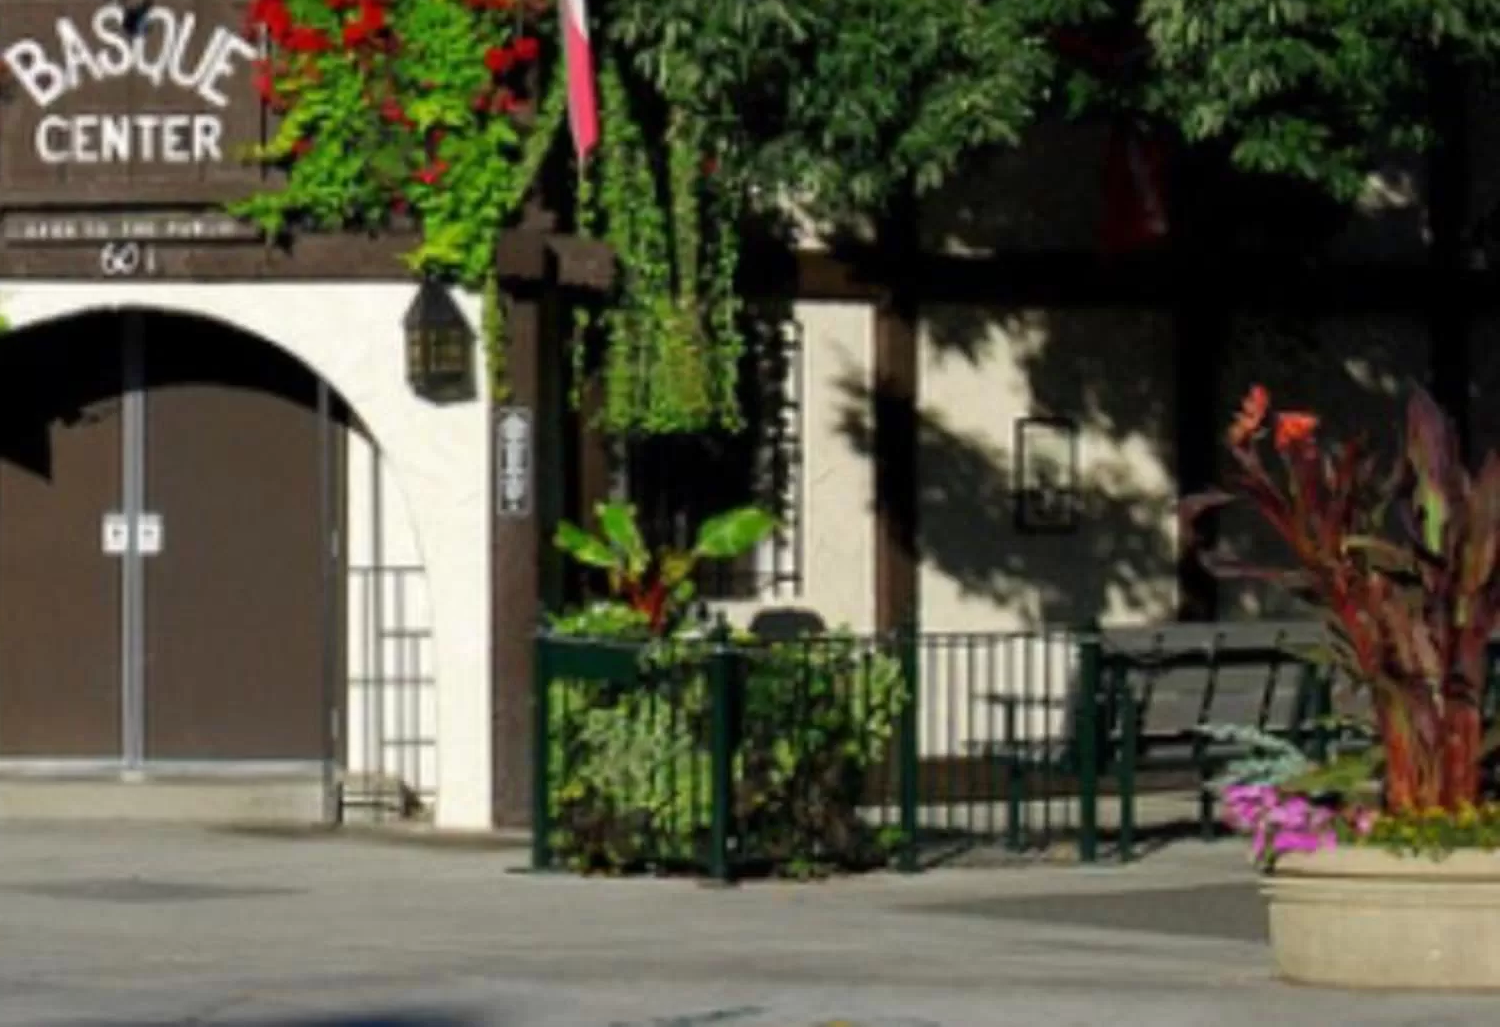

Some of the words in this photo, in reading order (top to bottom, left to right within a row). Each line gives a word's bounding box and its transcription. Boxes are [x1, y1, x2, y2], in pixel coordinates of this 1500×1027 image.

[4, 5, 258, 107] BASQUE
[35, 115, 223, 163] CENTER
[101, 242, 156, 275] 601
